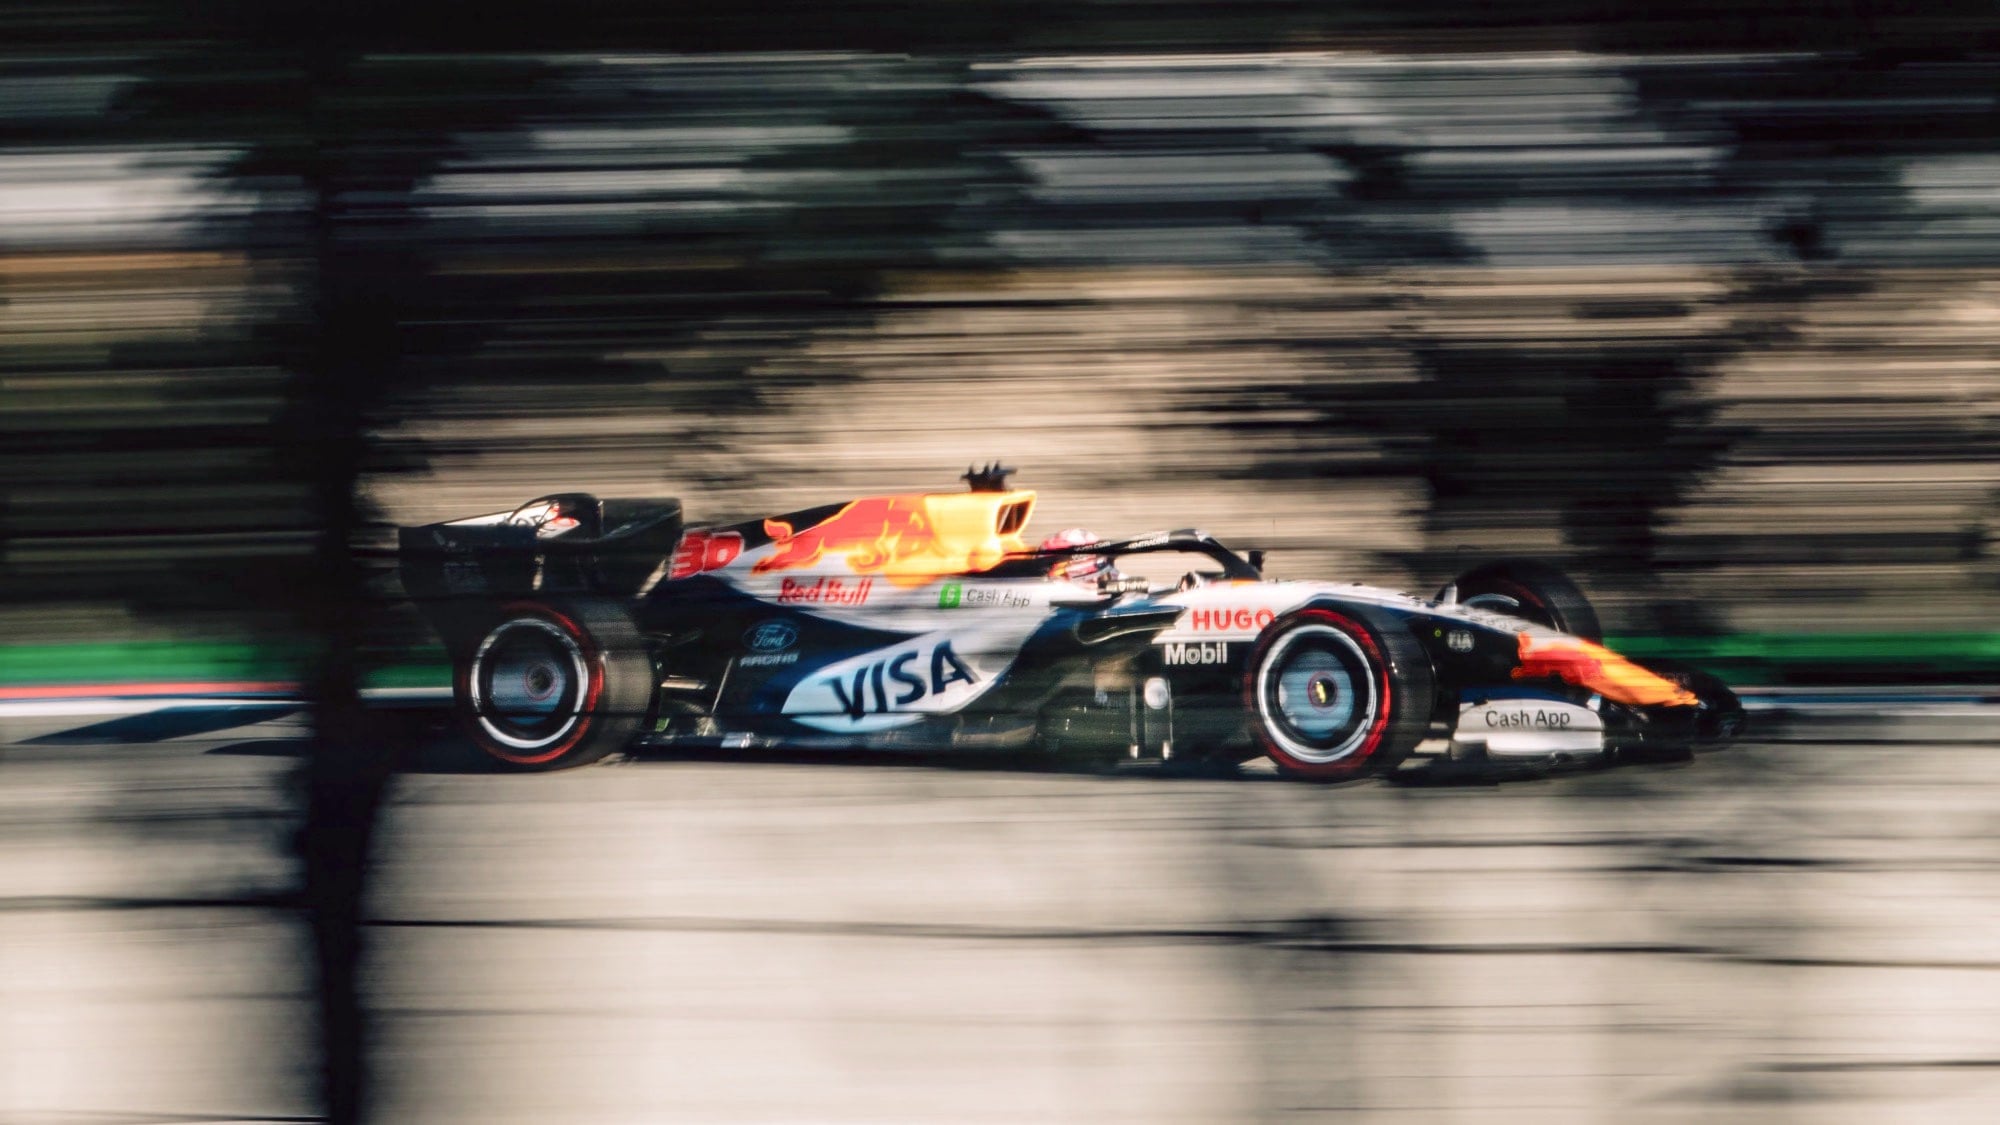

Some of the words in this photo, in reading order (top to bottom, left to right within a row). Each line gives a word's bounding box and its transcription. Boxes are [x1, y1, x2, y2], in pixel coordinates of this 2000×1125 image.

[777, 577, 824, 604] Red
[825, 577, 873, 605] Bull
[966, 588, 1001, 602] Cash
[1003, 588, 1030, 607] App
[1192, 609, 1275, 631] HUGO
[752, 625, 786, 647] Ford
[1164, 642, 1227, 665] Mobil
[819, 638, 981, 721] VISA
[1485, 709, 1530, 727] Cash
[1535, 709, 1571, 729] App
